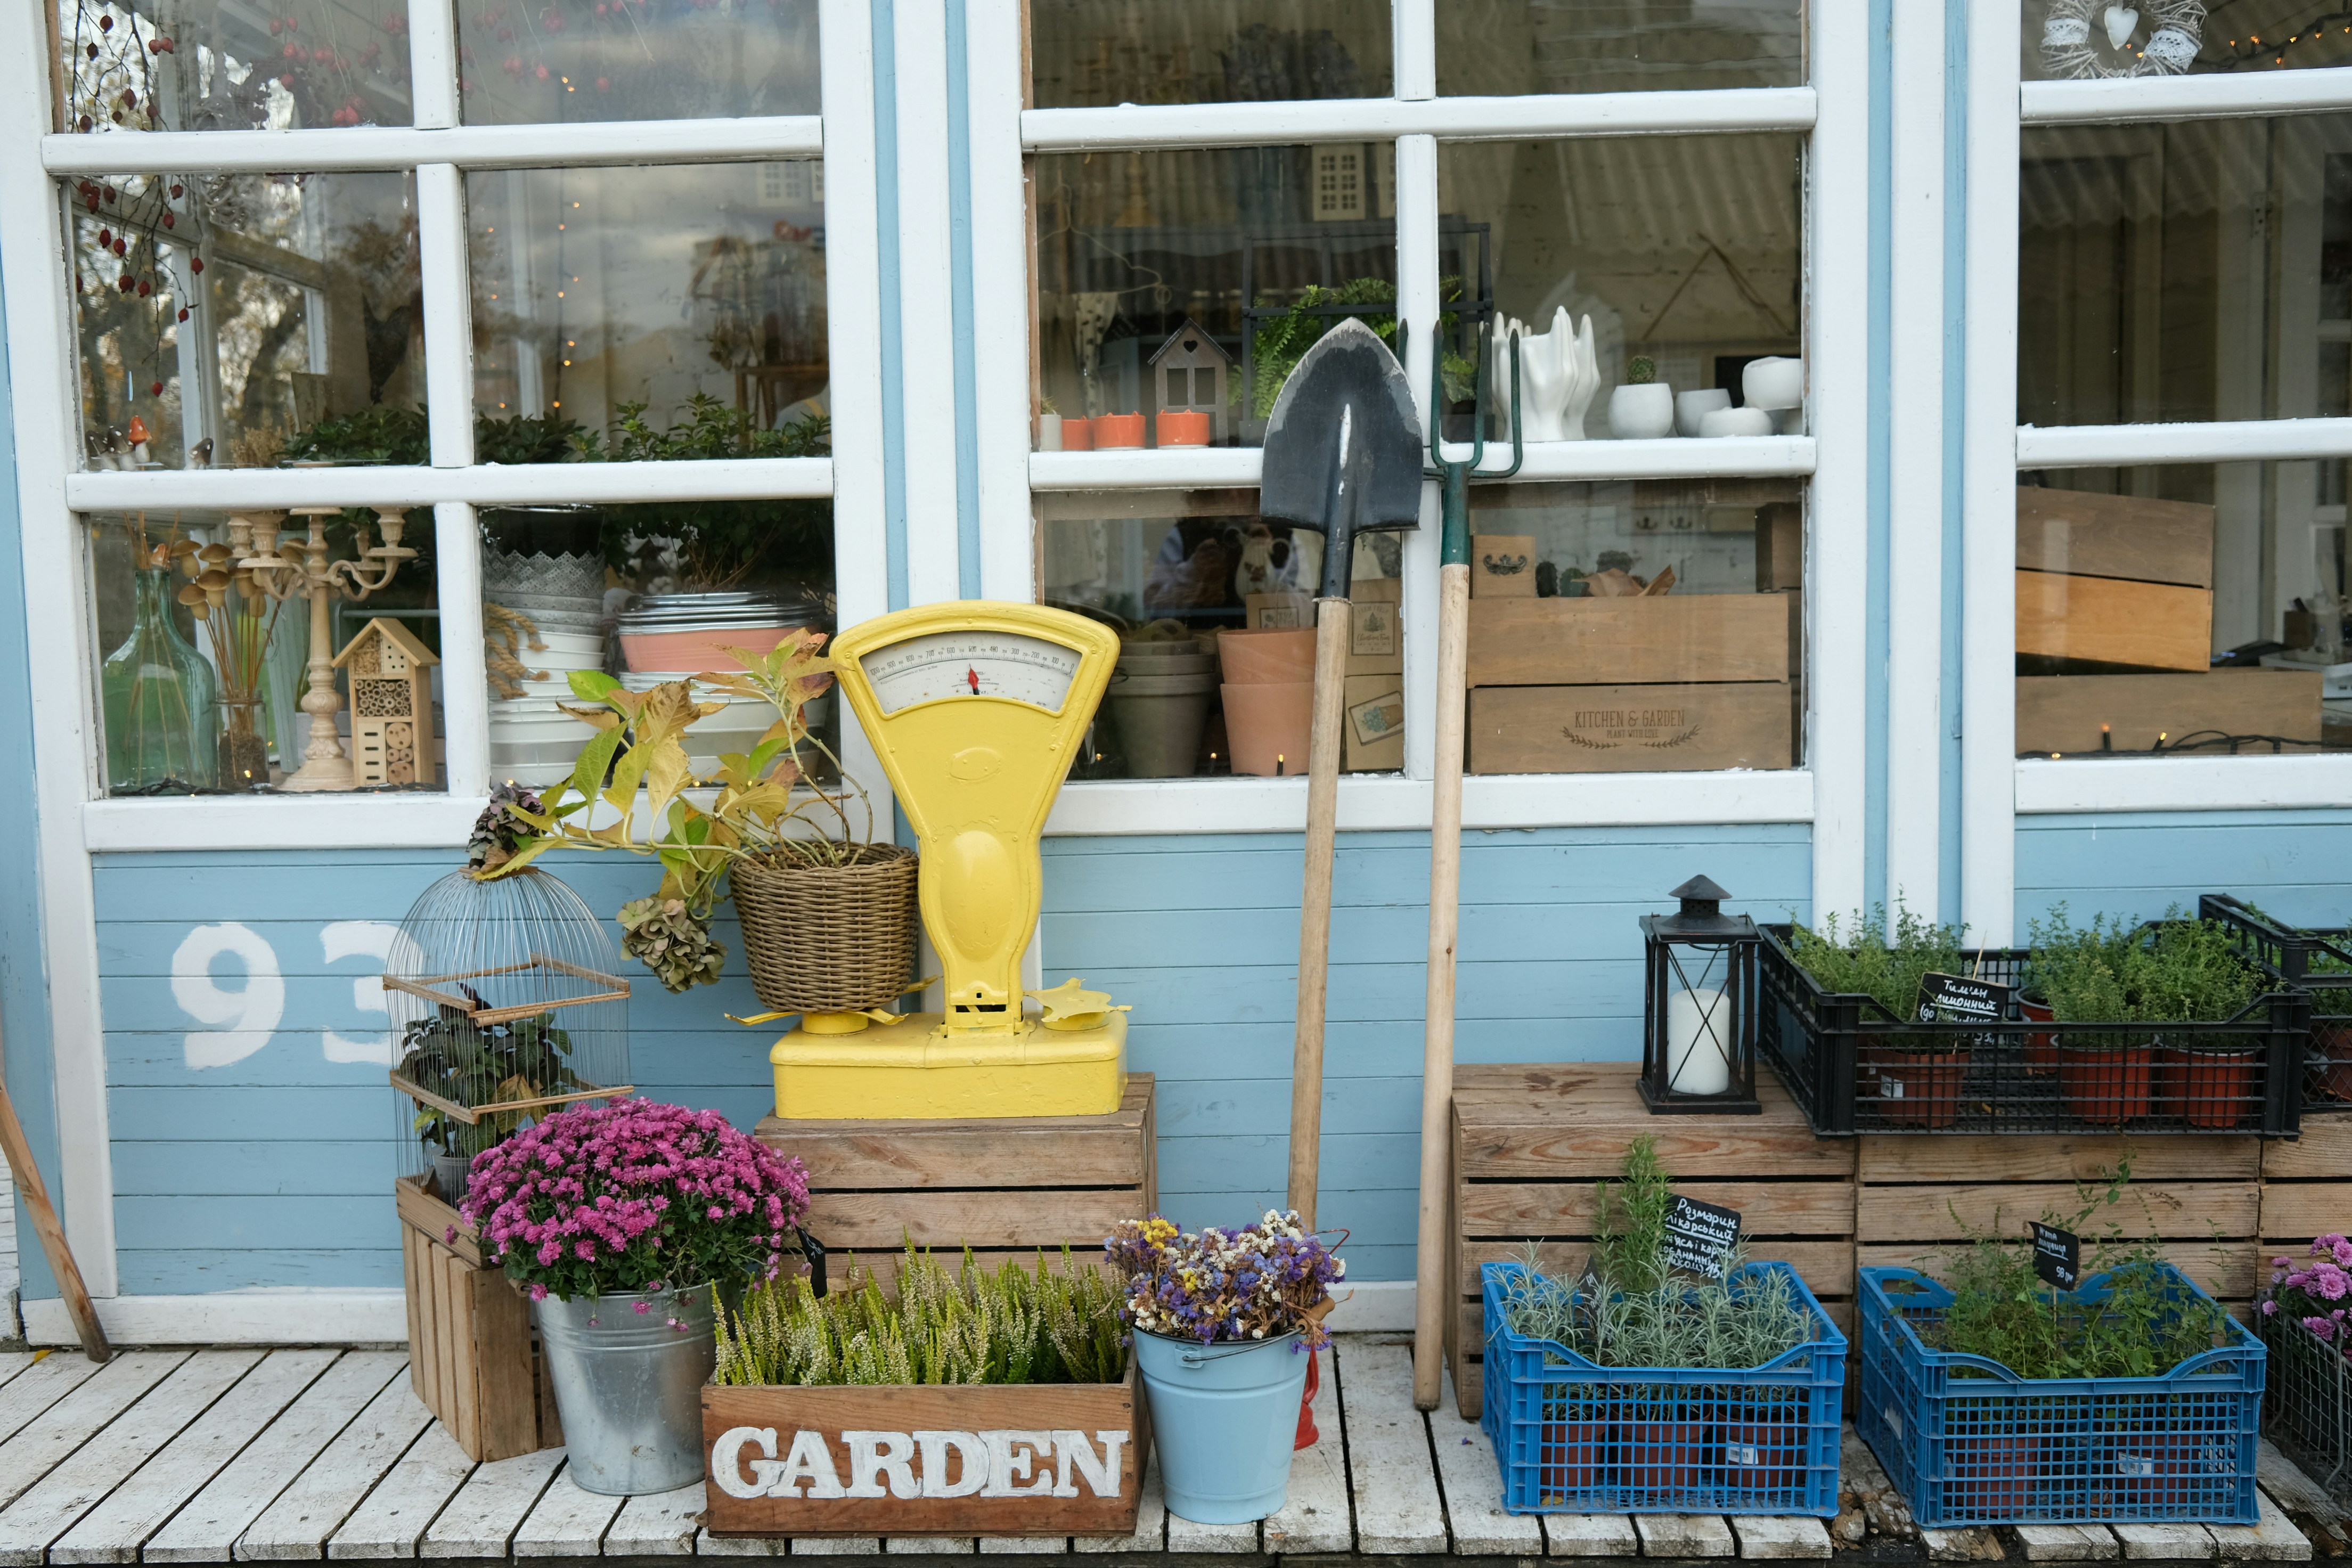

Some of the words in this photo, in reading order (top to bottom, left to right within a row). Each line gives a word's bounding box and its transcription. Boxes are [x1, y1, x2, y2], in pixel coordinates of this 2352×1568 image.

[870, 667, 880, 675] 1000
[926, 650, 934, 658] 700
[1575, 710, 1624, 728] KITCHEN
[1628, 710, 1638, 727] &
[1643, 709, 1685, 727] GARDEN
[1607, 729, 1624, 739] PLANT
[1628, 729, 1643, 738] WITH
[1645, 729, 1659, 738] LOVE
[170, 921, 427, 1070] 93
[1665, 1213, 1734, 1240] лікарський
[1677, 1198, 1737, 1229] Розмарин
[2056, 1265, 2064, 1278] 98
[711, 1426, 1130, 1499] GARDEN
